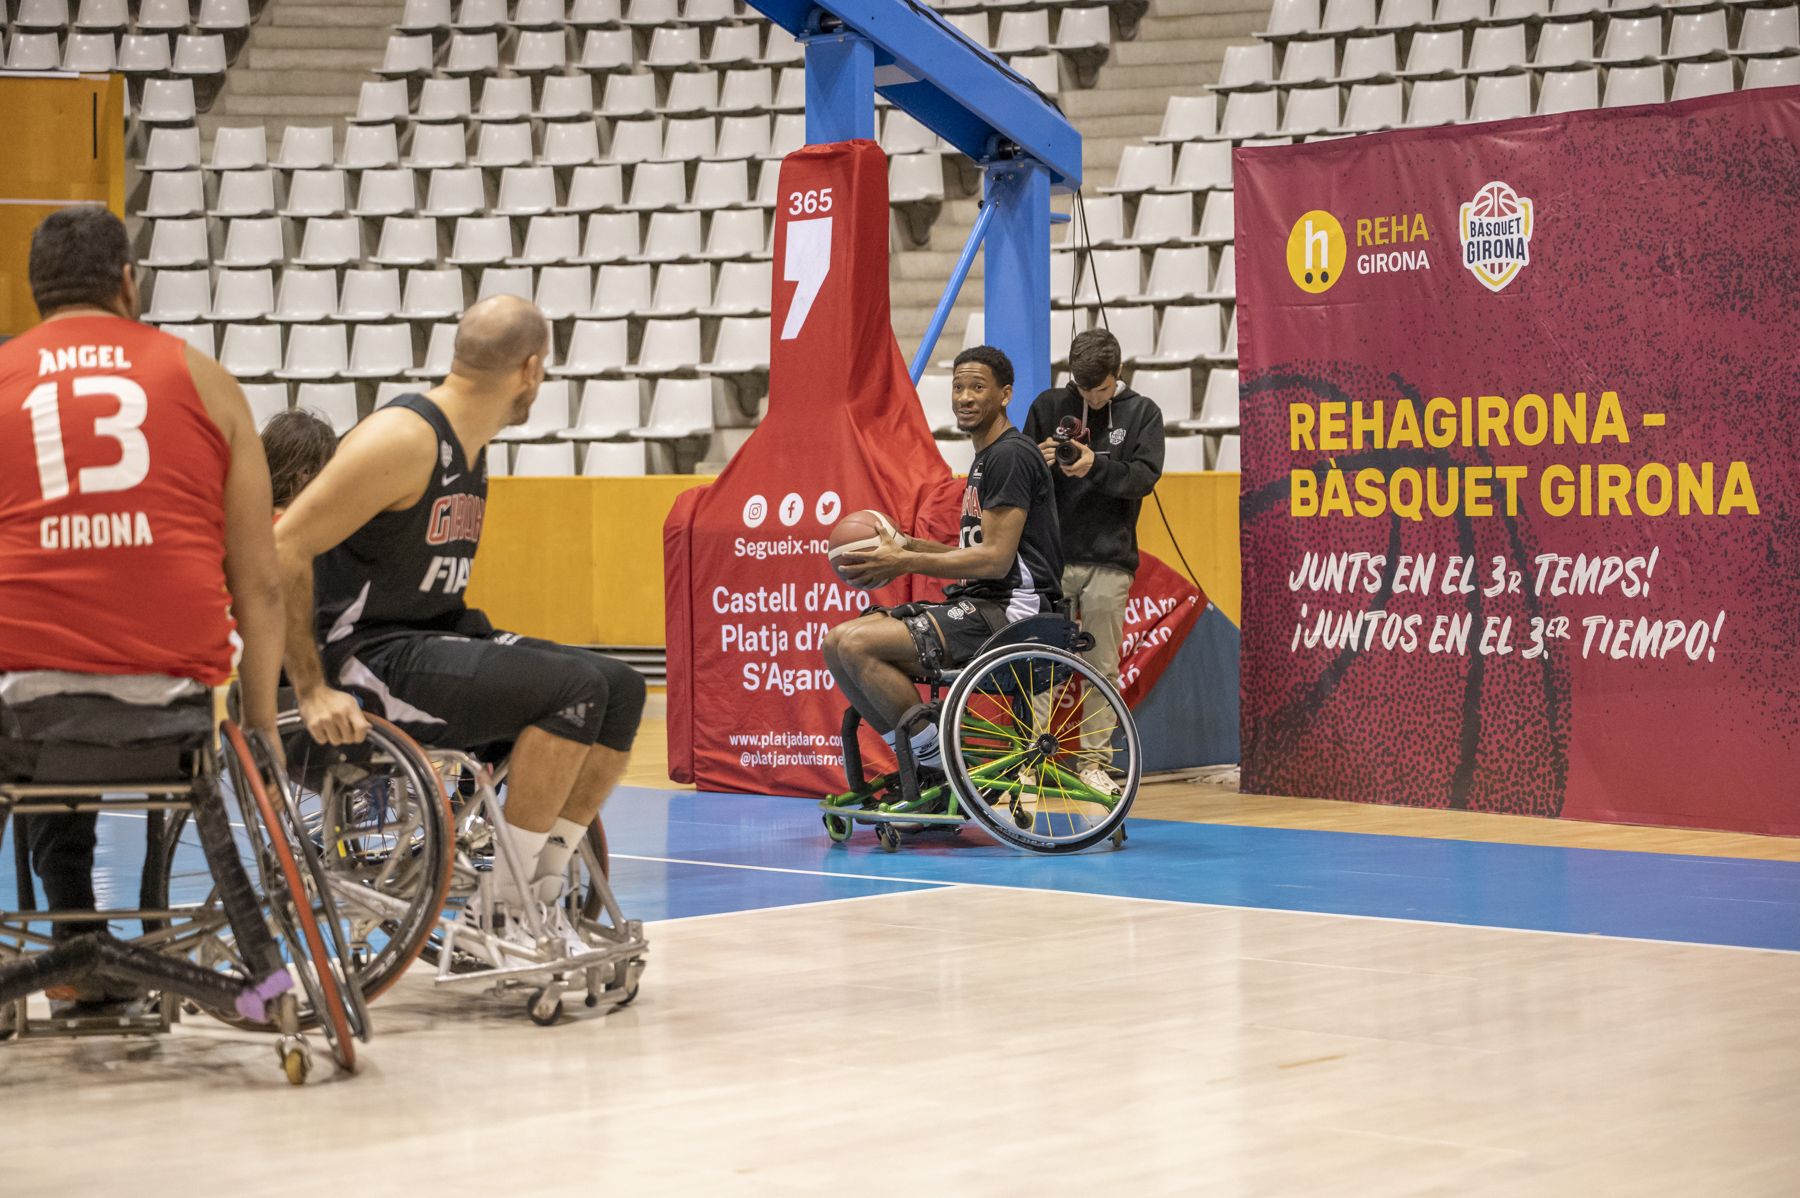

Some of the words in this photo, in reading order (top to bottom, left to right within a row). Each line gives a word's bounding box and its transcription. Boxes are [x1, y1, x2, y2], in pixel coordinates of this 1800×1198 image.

[788, 187, 833, 216] 365
[1357, 213, 1429, 247] REHA
[1470, 217, 1521, 238] BÀSQUET
[1357, 250, 1430, 275] GIRONA
[1466, 237, 1526, 265] GIRONA
[1290, 391, 1630, 451] REHAGIRONA
[21, 375, 150, 502] 13
[1290, 458, 1528, 521] BÀSQUET
[1540, 461, 1760, 517] GIRONA
[40, 511, 153, 550] GIRONA
[1289, 551, 1386, 594] JUNTS
[1392, 552, 1437, 596] EN
[1441, 554, 1476, 595] EL
[1535, 545, 1659, 598] TEMPS!
[712, 583, 797, 614] Castell
[804, 582, 870, 613] d'Aro
[721, 624, 788, 657] Platja
[1292, 603, 1422, 653] ¡JUNTOS
[1428, 612, 1472, 656] EN
[1479, 615, 1513, 656] EL
[1582, 610, 1725, 662] TIEMPO!
